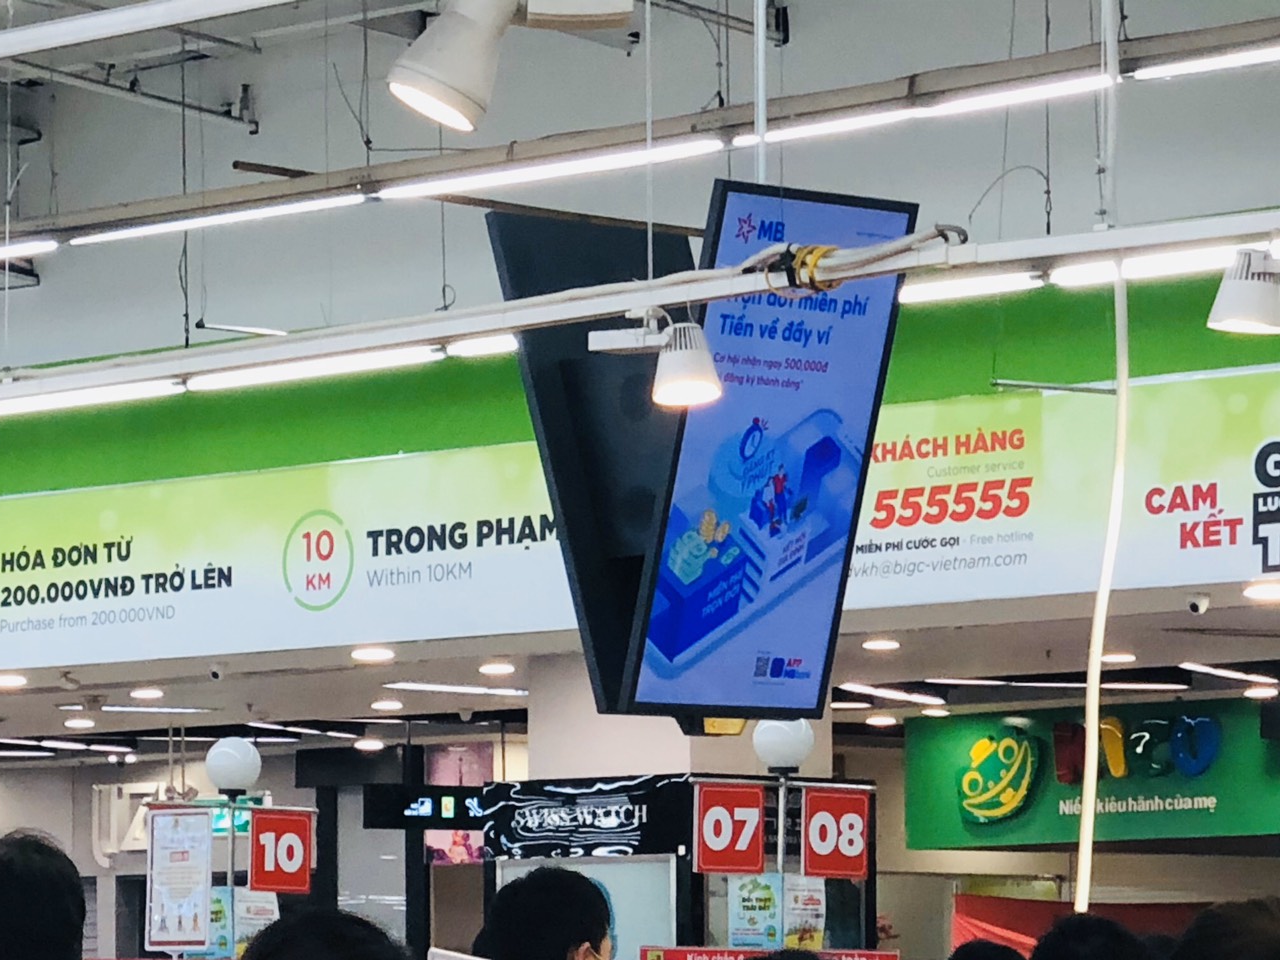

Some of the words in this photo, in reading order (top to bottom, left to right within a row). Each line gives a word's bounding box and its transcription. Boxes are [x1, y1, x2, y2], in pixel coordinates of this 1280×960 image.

[757, 220, 785, 242] MB
[955, 427, 1025, 456] HÀNG
[927, 465, 980, 479] Customer
[985, 460, 1025, 473] service
[870, 477, 1034, 529] 555555
[1145, 483, 1217, 515] CAM
[302, 529, 335, 562] 10
[366, 522, 468, 557] TRONG
[1180, 509, 1243, 549] KẾT
[1, 545, 46, 573] HÓA
[52, 542, 98, 568] ĐƠN
[103, 535, 133, 562] TỪ
[0, 576, 135, 607] 200.000VNĐ
[141, 563, 185, 593] TRỞ
[191, 562, 232, 591] LÊN
[305, 572, 331, 591] KM
[366, 567, 421, 588] Within
[427, 561, 472, 583] 10KM
[0, 614, 55, 634] Purchase
[58, 612, 87, 629] from
[703, 806, 759, 851] 07
[809, 811, 864, 857] 08
[259, 832, 304, 873] 10
